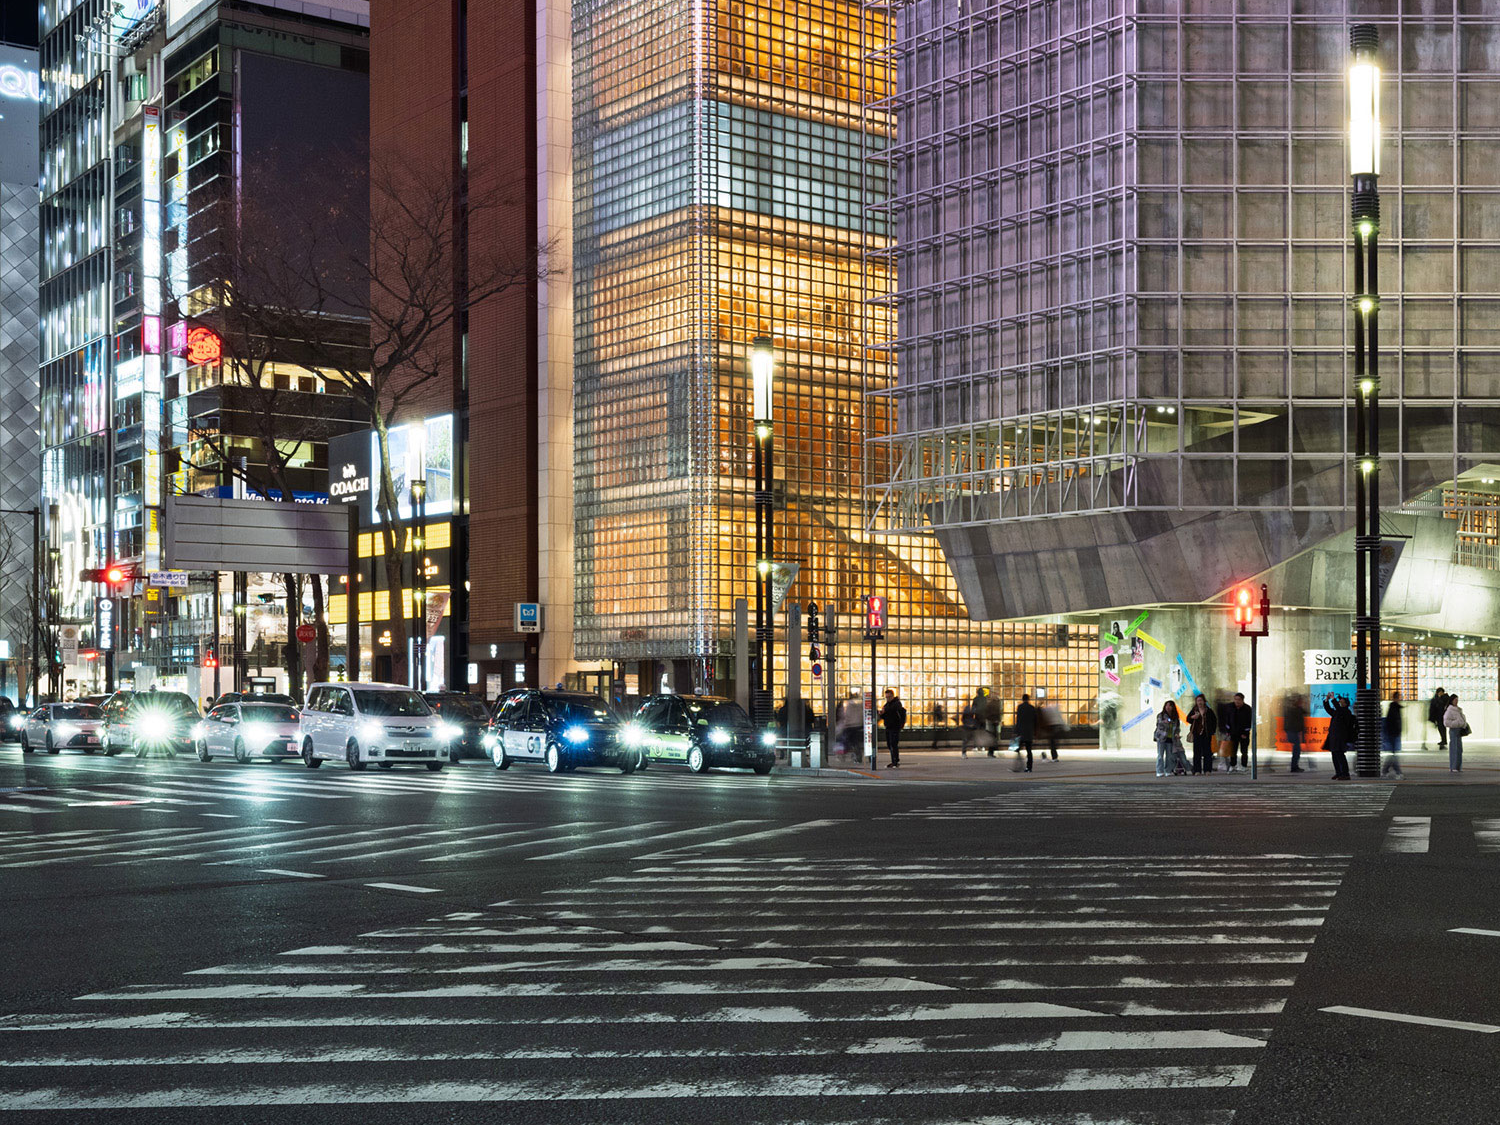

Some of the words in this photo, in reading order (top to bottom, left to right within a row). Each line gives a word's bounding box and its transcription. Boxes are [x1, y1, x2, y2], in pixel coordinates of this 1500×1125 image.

[330, 477, 369, 496] COACH
[1315, 654, 1351, 668] Sony
[1315, 669, 1350, 681] Park
[527, 736, 541, 753] GO
